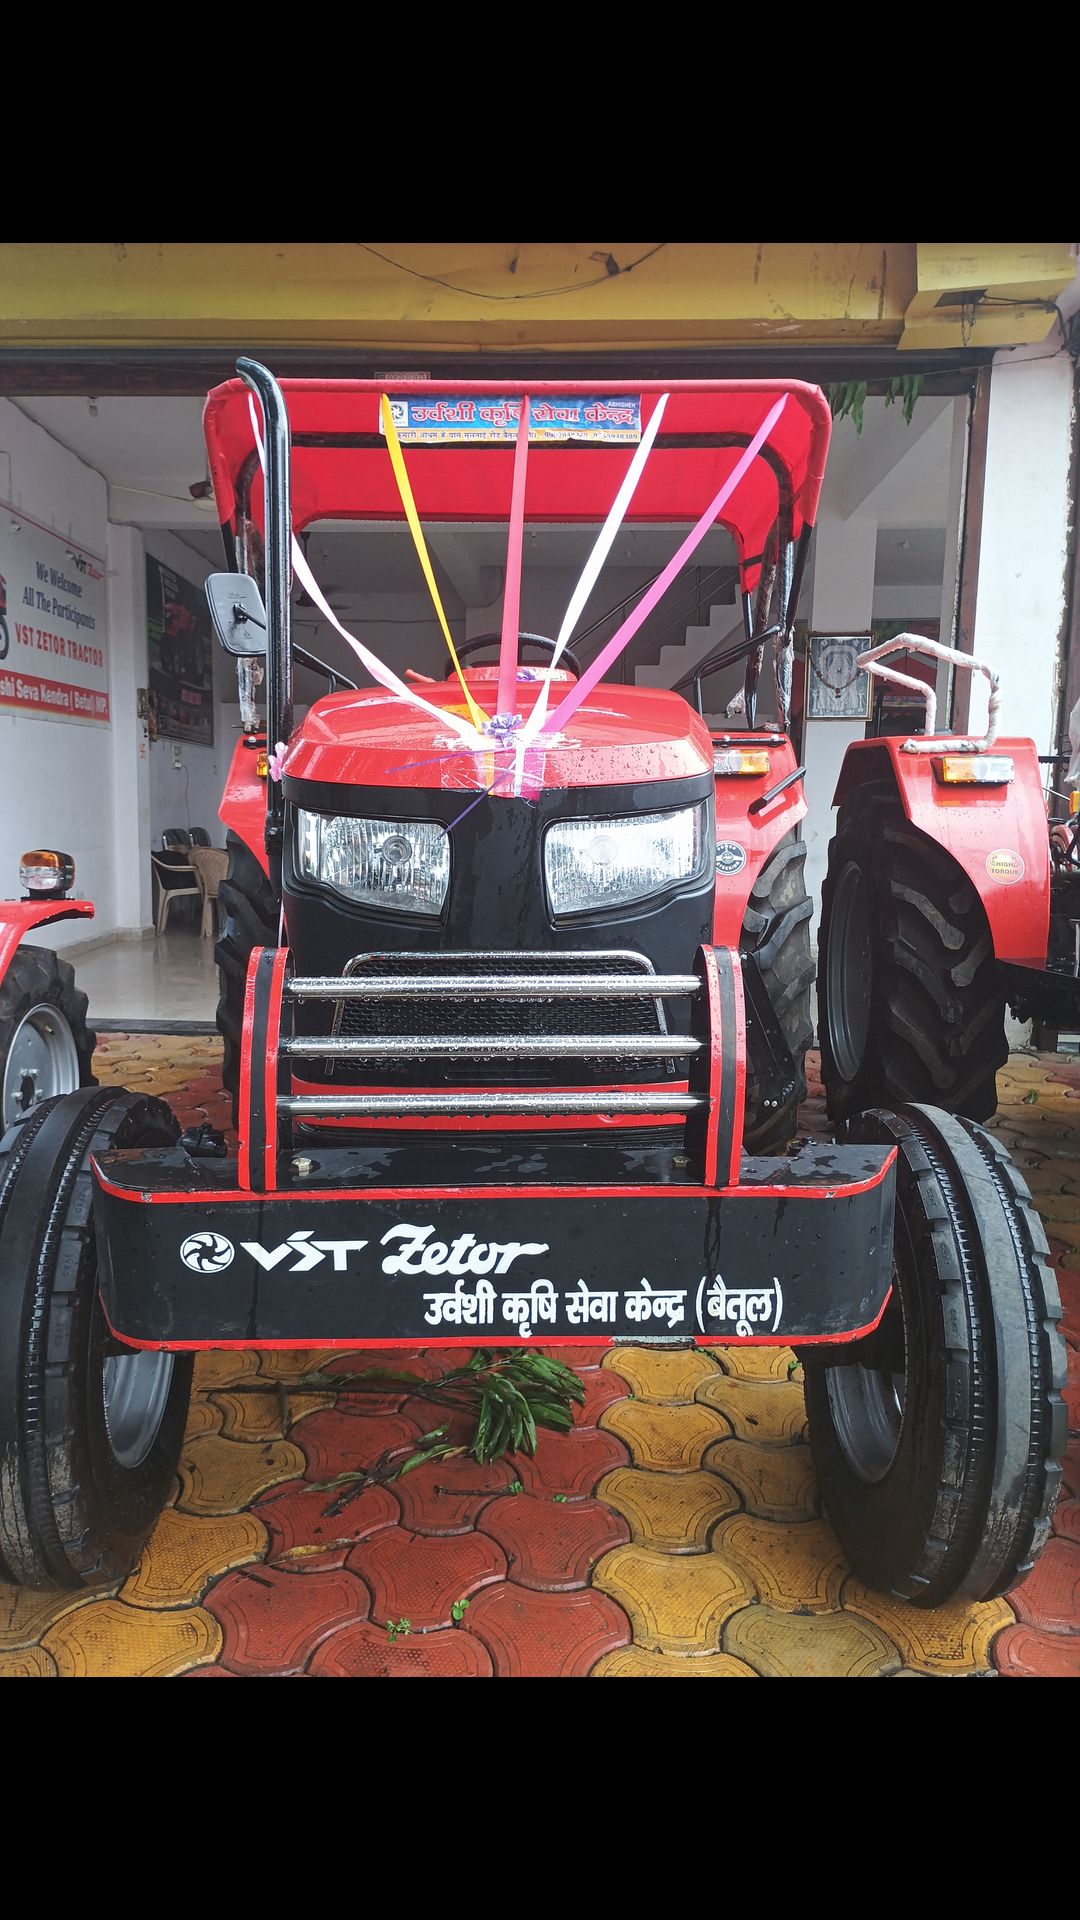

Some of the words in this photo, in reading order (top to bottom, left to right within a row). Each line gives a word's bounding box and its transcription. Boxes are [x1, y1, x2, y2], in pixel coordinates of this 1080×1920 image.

[411, 401, 477, 423] उर्वशी
[532, 402, 580, 422] सेवा
[584, 401, 635, 425] केन्द्र
[607, 401, 637, 409] ABHISHEK
[36, 560, 49, 583] We
[49, 567, 82, 598] Welcome
[22, 585, 34, 608] All
[36, 590, 51, 613] The
[52, 597, 96, 631] Participants
[15, 622, 34, 647] VST
[36, 629, 65, 657] ZETOR
[67, 639, 104, 668] TRACTOR
[16, 678, 39, 702] Seva
[40, 683, 69, 708] Kendra
[991, 868, 1020, 876] TORQUE
[240, 1230, 369, 1272] VST
[380, 1223, 550, 1276] Zetor
[423, 1278, 498, 1326] उर्वशी
[502, 1278, 559, 1338] कृषि
[565, 1278, 619, 1325] सेवा
[624, 1277, 688, 1328] केन्द्र
[696, 1274, 784, 1337] (बैतूल)
